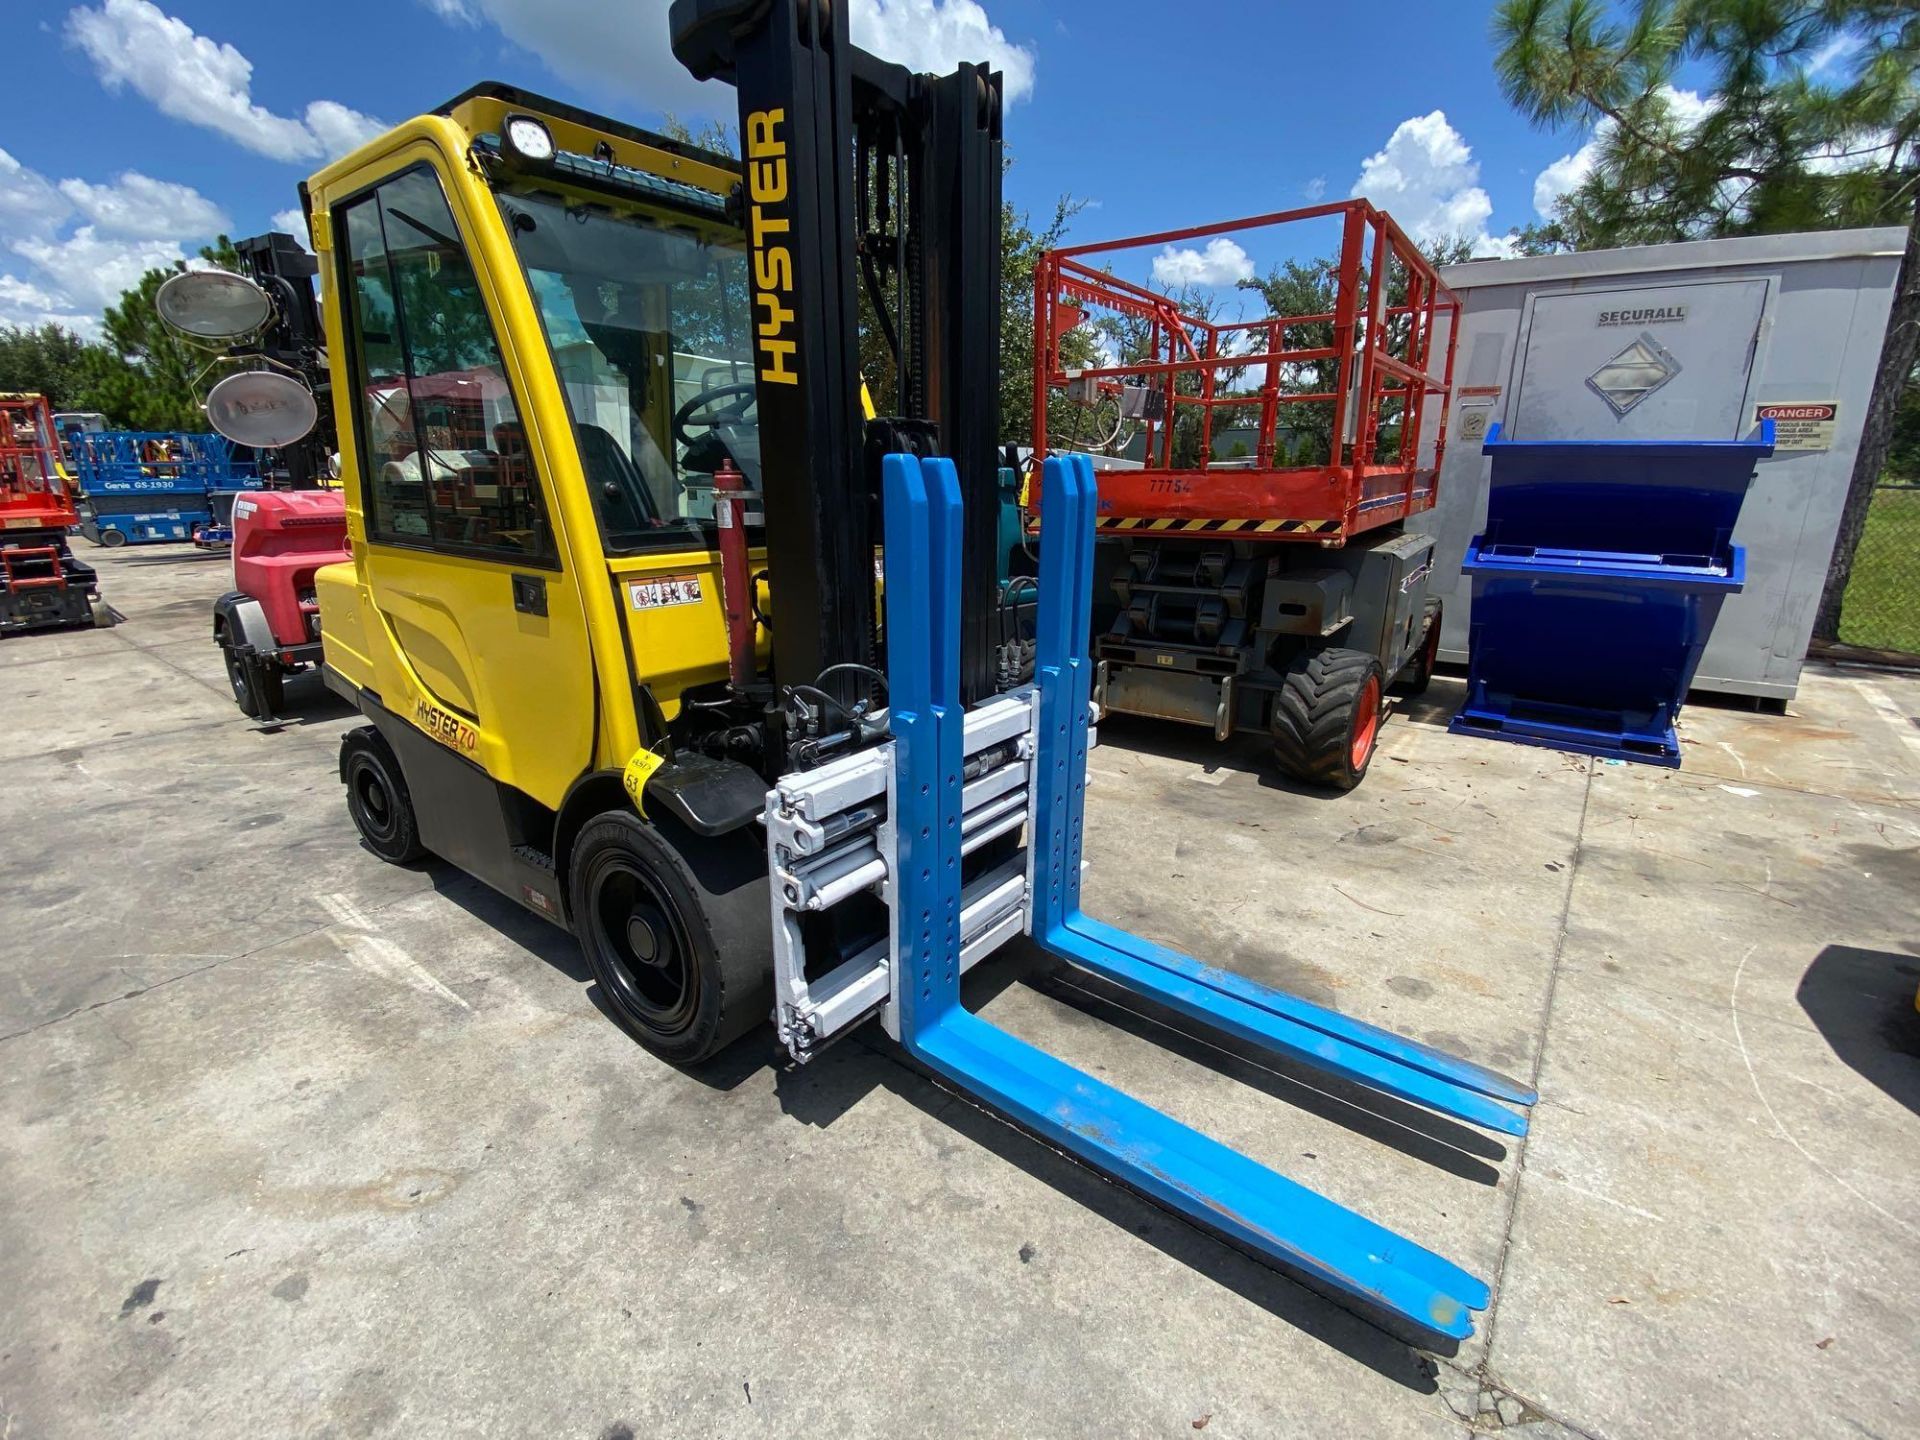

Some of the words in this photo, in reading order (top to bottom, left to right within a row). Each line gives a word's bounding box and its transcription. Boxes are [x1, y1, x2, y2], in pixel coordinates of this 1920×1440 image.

[747, 107, 798, 385] HYSTER
[1599, 307, 1685, 323] SECURALL
[1768, 408, 1823, 418] DANGER
[134, 481, 174, 489] GS-1930
[1150, 479, 1192, 493] 77754
[417, 698, 459, 739] HYSTER
[460, 726, 476, 750] 70
[626, 774, 639, 792] 53
